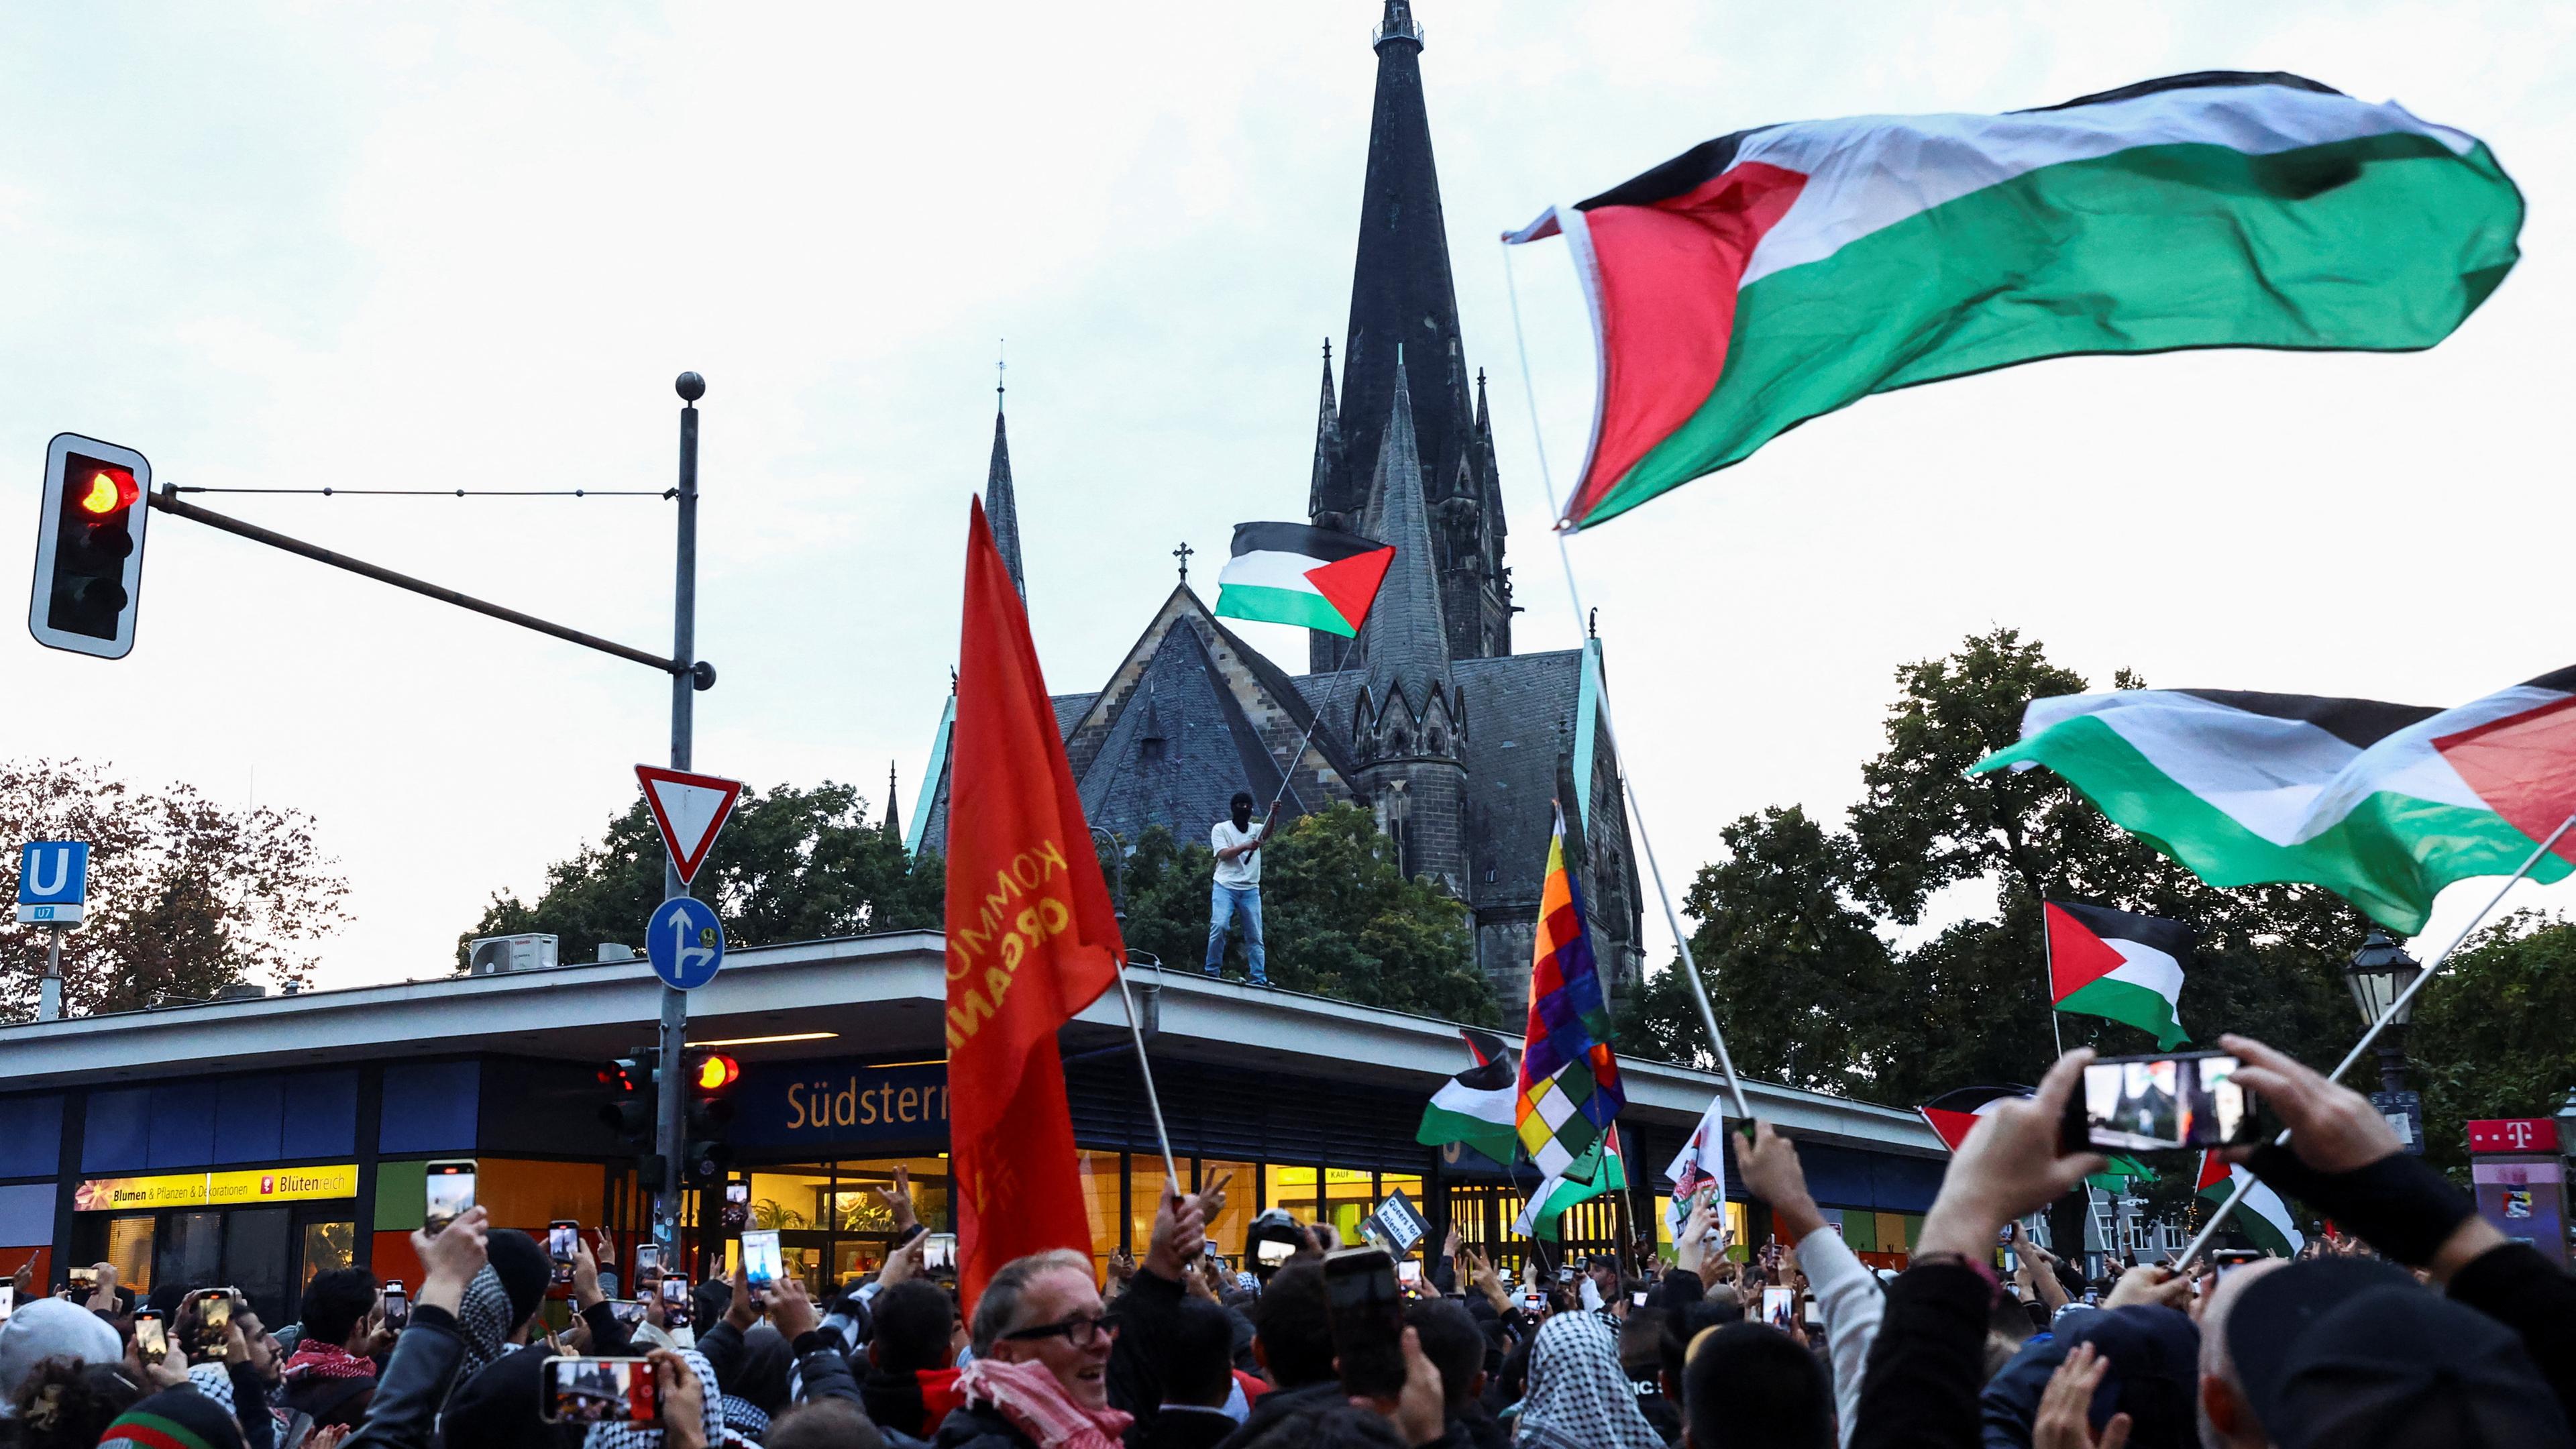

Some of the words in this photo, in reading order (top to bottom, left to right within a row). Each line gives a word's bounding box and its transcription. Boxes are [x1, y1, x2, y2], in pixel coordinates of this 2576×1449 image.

[30, 848, 69, 896] U
[38, 908, 51, 917] U7
[280, 1173, 345, 1192] Blütenreich
[1330, 1169, 1350, 1179] KAUF
[114, 1189, 146, 1201] Blumen
[149, 1188, 155, 1199] &
[156, 1186, 188, 1199] Pflanzen
[191, 1185, 196, 1197] &
[199, 1183, 248, 1197] Dekorationen
[1382, 1210, 1408, 1244] Palestine
[1389, 1200, 1409, 1226] Queers
[1407, 1224, 1419, 1236] for
